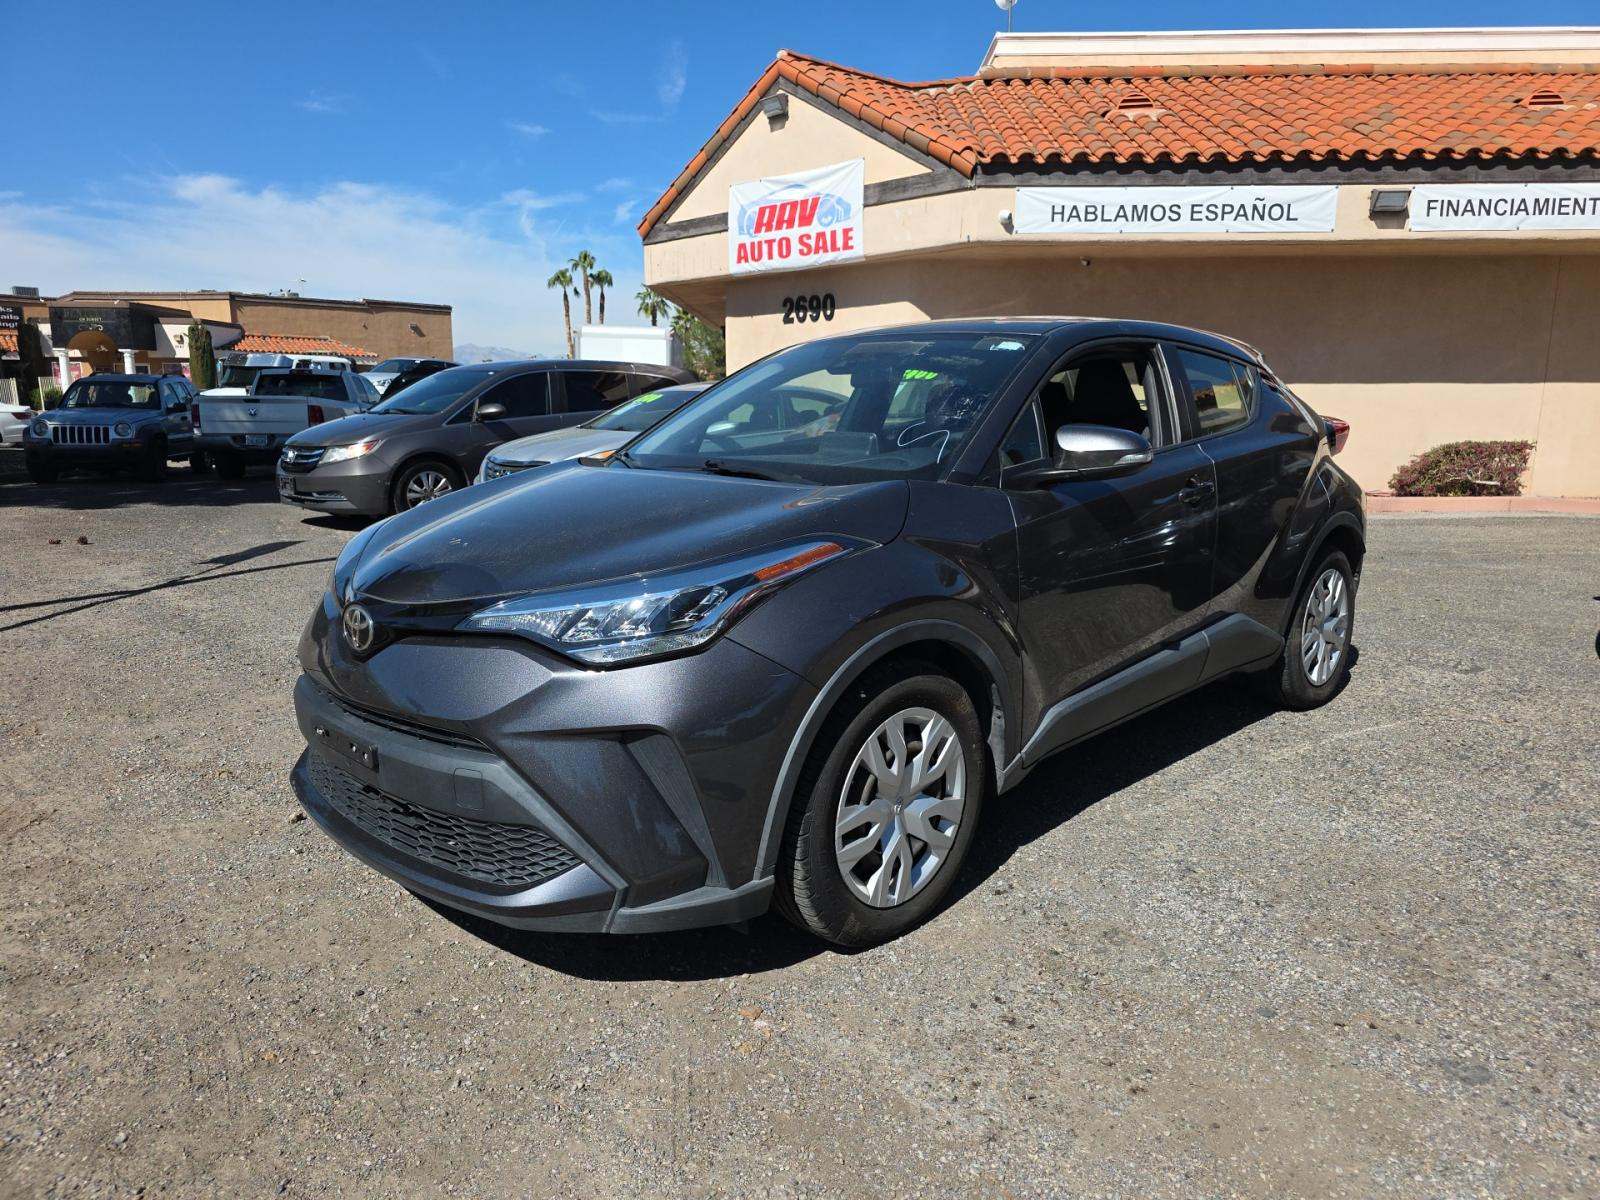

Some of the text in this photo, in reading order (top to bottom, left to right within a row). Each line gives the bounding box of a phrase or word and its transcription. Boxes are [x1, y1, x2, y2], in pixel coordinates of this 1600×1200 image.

[754, 196, 820, 235] AAV
[1050, 197, 1298, 223] HABLAMOS ESPAÑOL
[1426, 197, 1600, 217] FINANCIAMIENT
[736, 227, 854, 264] AUTO SALE
[782, 293, 835, 325] 2690
